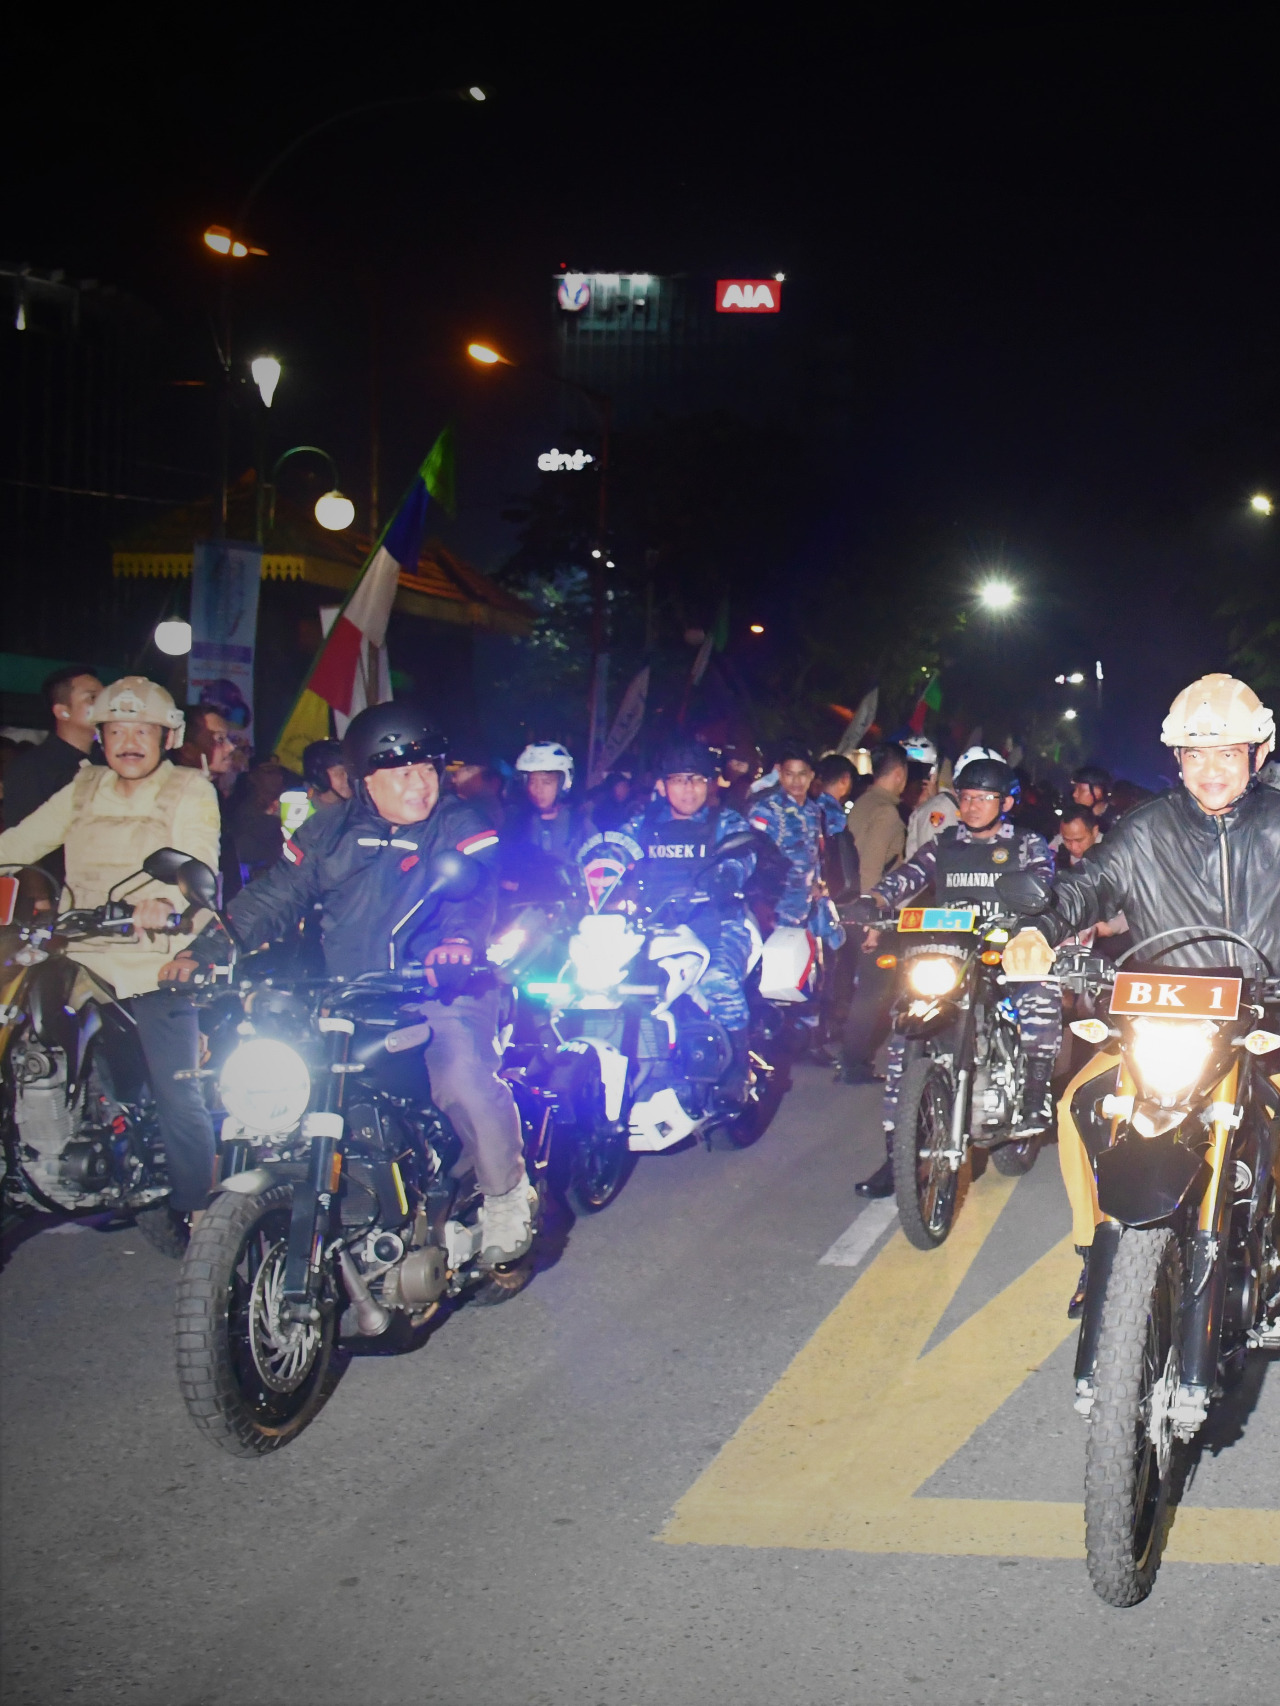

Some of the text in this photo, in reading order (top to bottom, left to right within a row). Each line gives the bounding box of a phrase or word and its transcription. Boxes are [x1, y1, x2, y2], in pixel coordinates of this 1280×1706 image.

[722, 284, 775, 308] AIA
[648, 844, 695, 858] KOSEK
[1126, 981, 1225, 1009] BK 1
